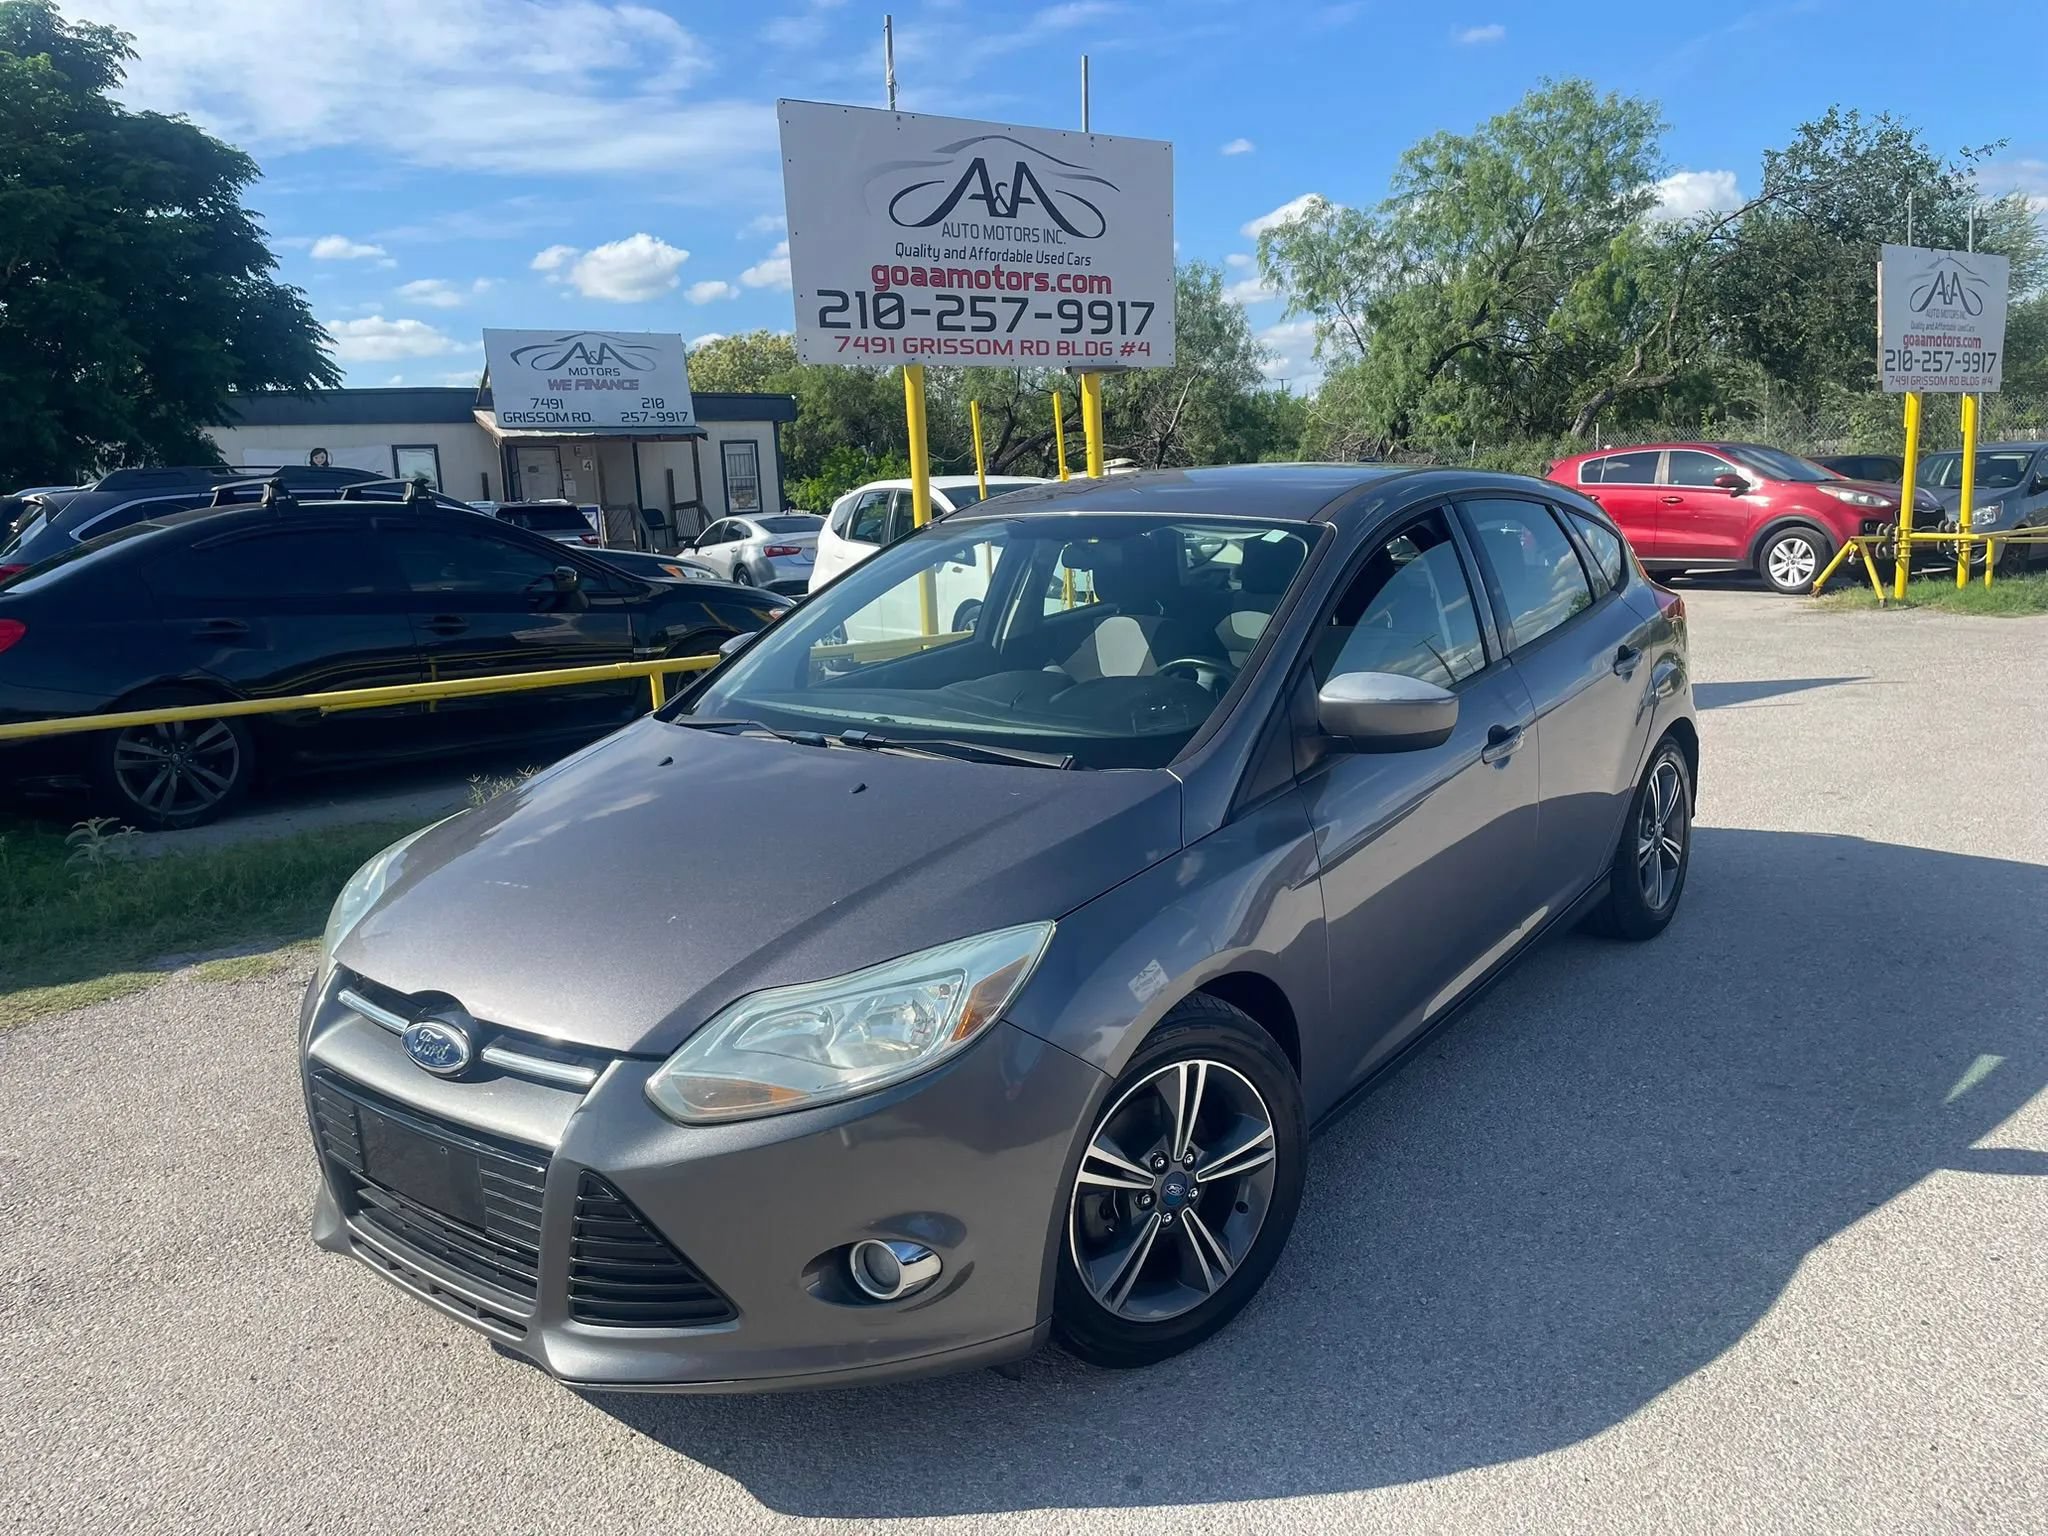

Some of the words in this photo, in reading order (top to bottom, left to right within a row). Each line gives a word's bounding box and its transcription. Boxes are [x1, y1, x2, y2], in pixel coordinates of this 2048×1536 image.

[942, 222, 980, 239] AUTO
[983, 224, 1040, 243] MOTORS
[1043, 229, 1067, 245] INC.
[895, 242, 940, 262] Quality
[944, 246, 966, 260] and
[969, 246, 1033, 264] Affordable
[1036, 250, 1064, 265] Used
[1067, 252, 1091, 266] Cars
[871, 264, 1112, 295] goaamotors.com
[816, 289, 1155, 336] 210-257-9917
[834, 335, 895, 354] 7491
[903, 336, 1013, 356] GRISSOM
[1021, 339, 1050, 356] RD
[1057, 340, 1113, 357] BLDG
[1120, 341, 1152, 357] #4
[1903, 332, 1982, 349] goaamotors.com
[1884, 349, 1997, 373] 210-257-9917
[568, 367, 621, 377] MOTORS
[548, 378, 572, 391] WE
[575, 378, 640, 391] FINANCE
[1889, 375, 1910, 386] 7491
[1911, 375, 1949, 386] GRISSOM
[1950, 375, 1960, 386] RD
[1961, 375, 1979, 386] BLDG
[1981, 376, 1993, 386] #4
[530, 397, 564, 410] 7491
[641, 397, 665, 409] 210
[503, 411, 570, 423] GRISSOM
[572, 411, 595, 423] RD.
[620, 411, 688, 423] 257-9917
[583, 460, 592, 471] 4
[413, 1028, 451, 1061] Ford
